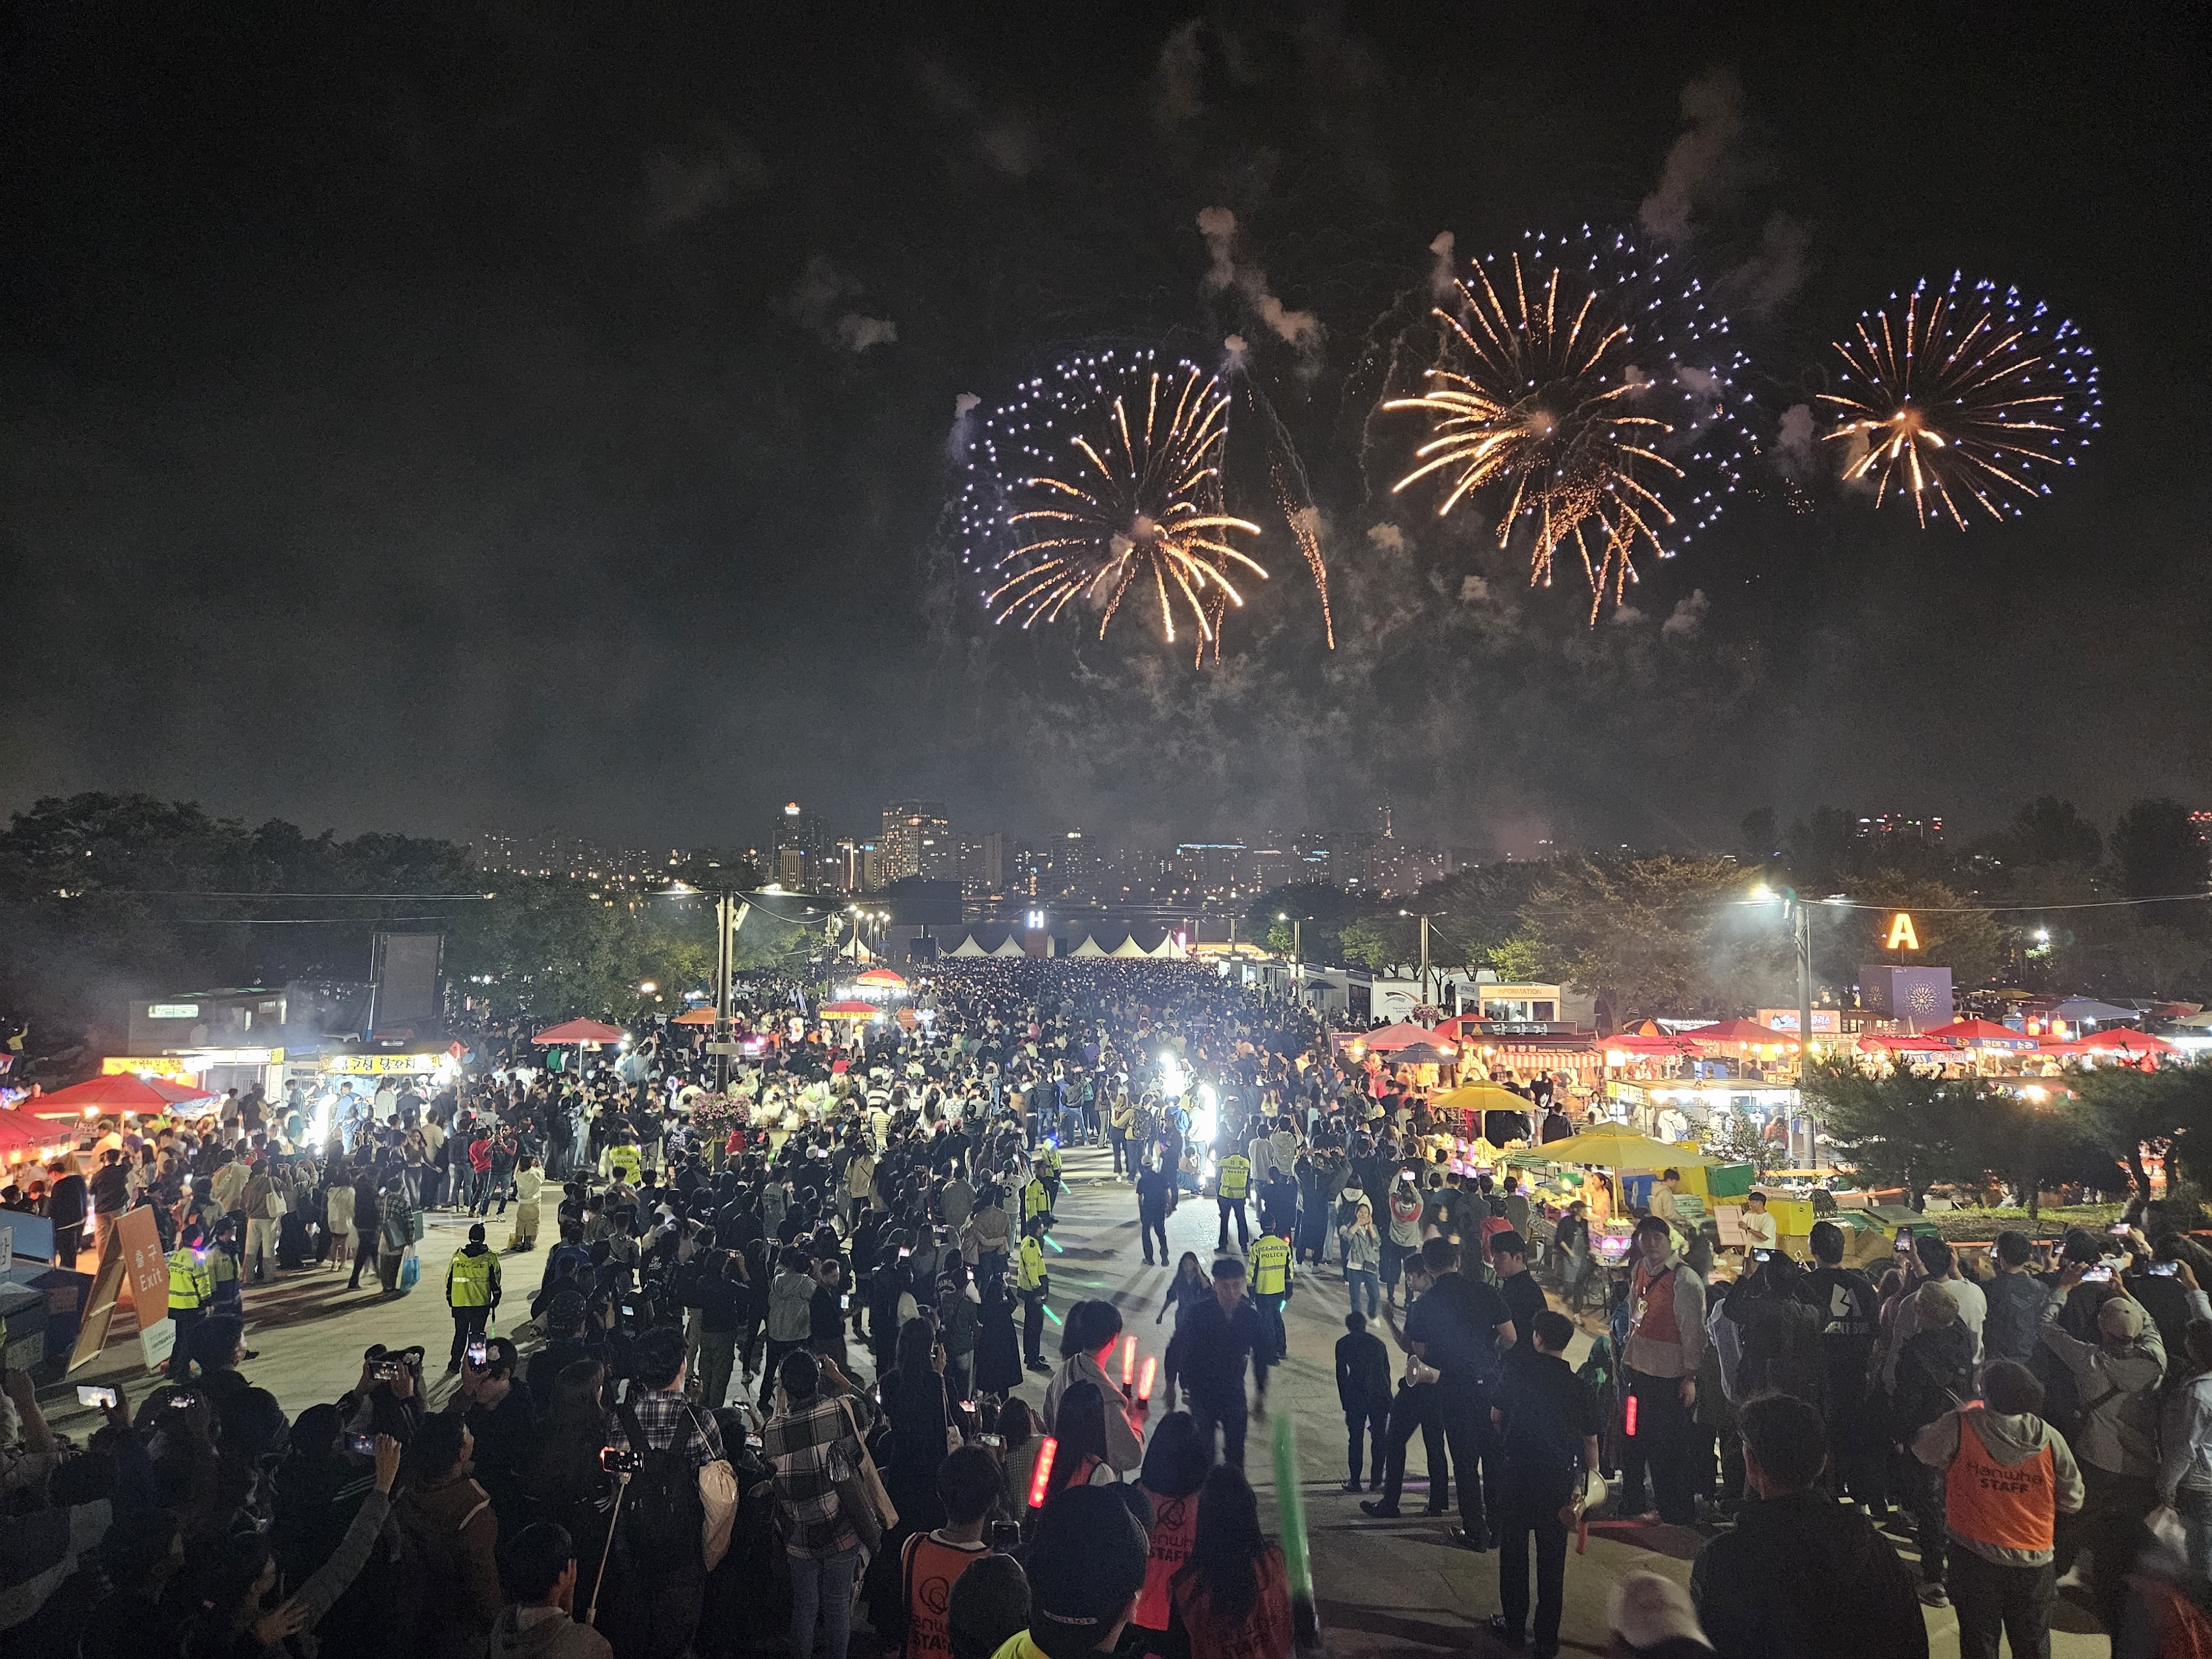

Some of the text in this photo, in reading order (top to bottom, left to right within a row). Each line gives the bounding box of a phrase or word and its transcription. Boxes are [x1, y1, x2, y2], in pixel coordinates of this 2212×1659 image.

[1029, 910, 1044, 928] H
[1887, 914, 1919, 950] A
[1982, 1039, 2034, 1050] 번데기 소라
[135, 1244, 158, 1269] 출구
[139, 1267, 163, 1292] Exit
[1966, 1462, 2043, 1485] Hanwha
[1981, 1478, 2028, 1493] STAFF
